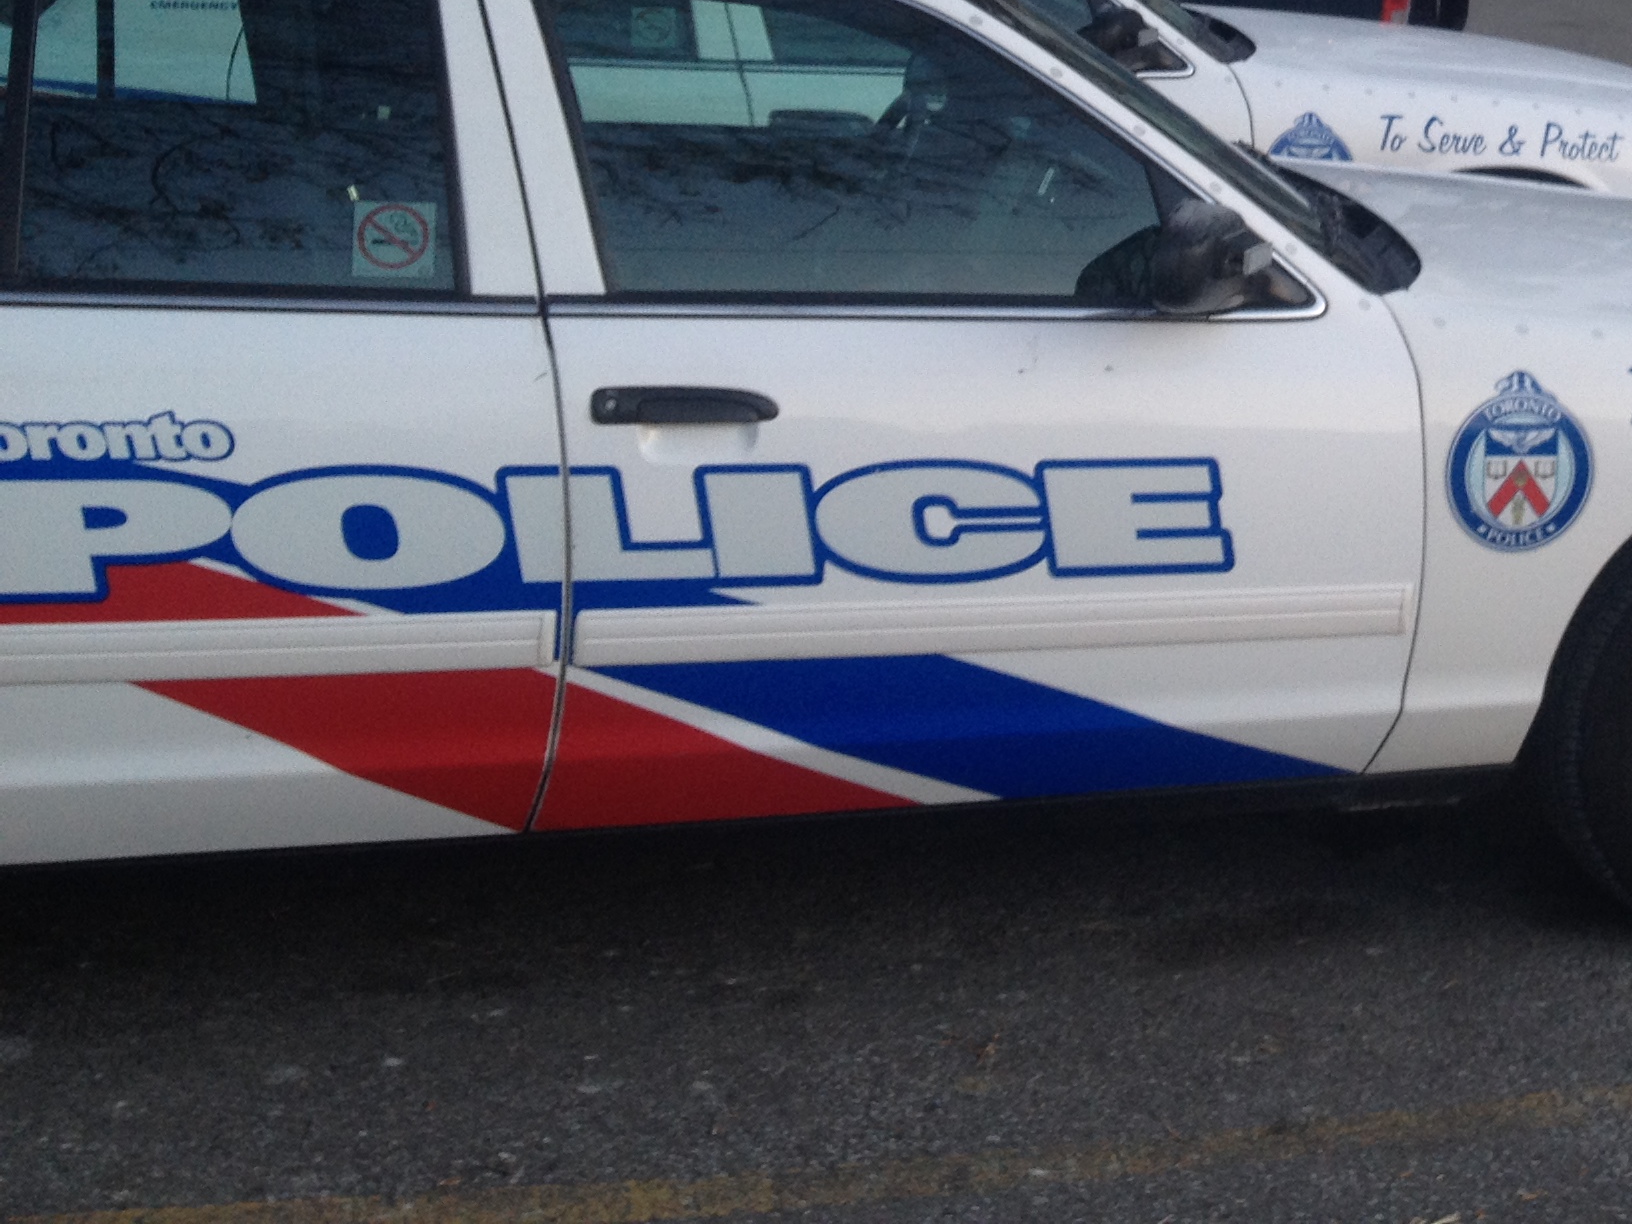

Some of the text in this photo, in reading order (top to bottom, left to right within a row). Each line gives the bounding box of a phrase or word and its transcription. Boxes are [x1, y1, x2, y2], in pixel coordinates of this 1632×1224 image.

[150, 0, 238, 10] EMERGENCY
[1380, 114, 1407, 152] To
[1417, 115, 1487, 155] Serve
[1499, 124, 1525, 155] &
[1540, 122, 1624, 161] Protect
[1484, 398, 1563, 421] TORONTO
[0, 458, 1235, 604] POLICE
[1486, 529, 1545, 546] POLICE
